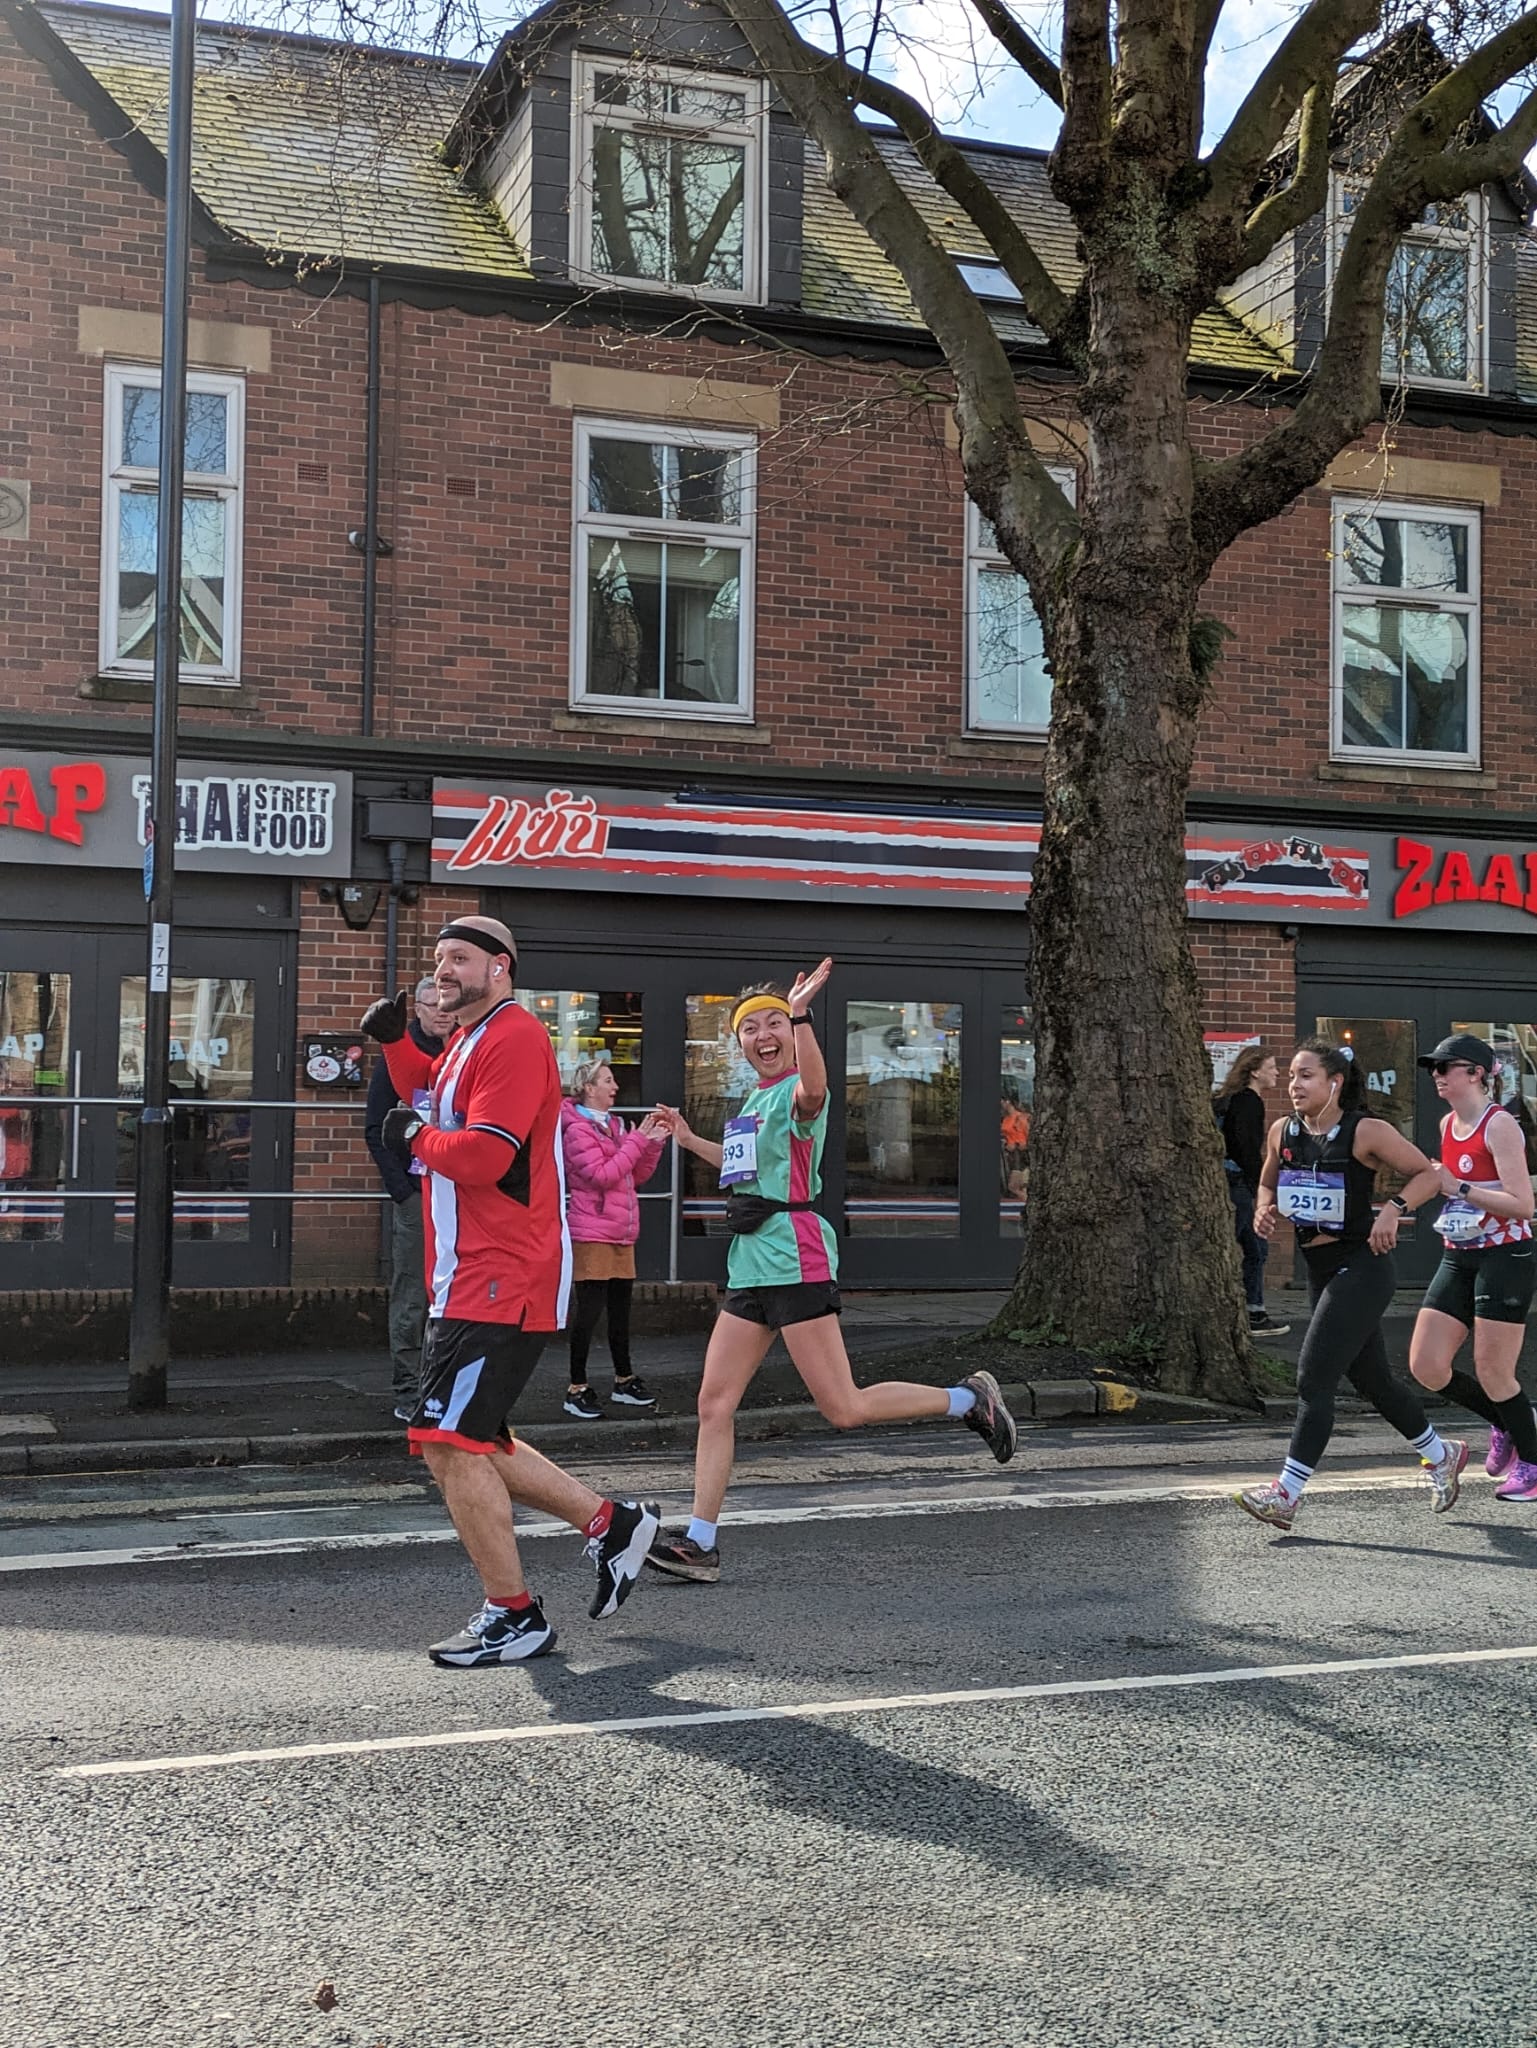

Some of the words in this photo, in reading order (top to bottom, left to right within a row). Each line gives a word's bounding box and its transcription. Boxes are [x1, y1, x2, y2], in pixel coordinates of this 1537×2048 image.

[254, 783, 330, 813] STREET
[254, 812, 327, 850] FOOD
[1394, 836, 1537, 918] ZAA
[1290, 1194, 1332, 1211] 2512
